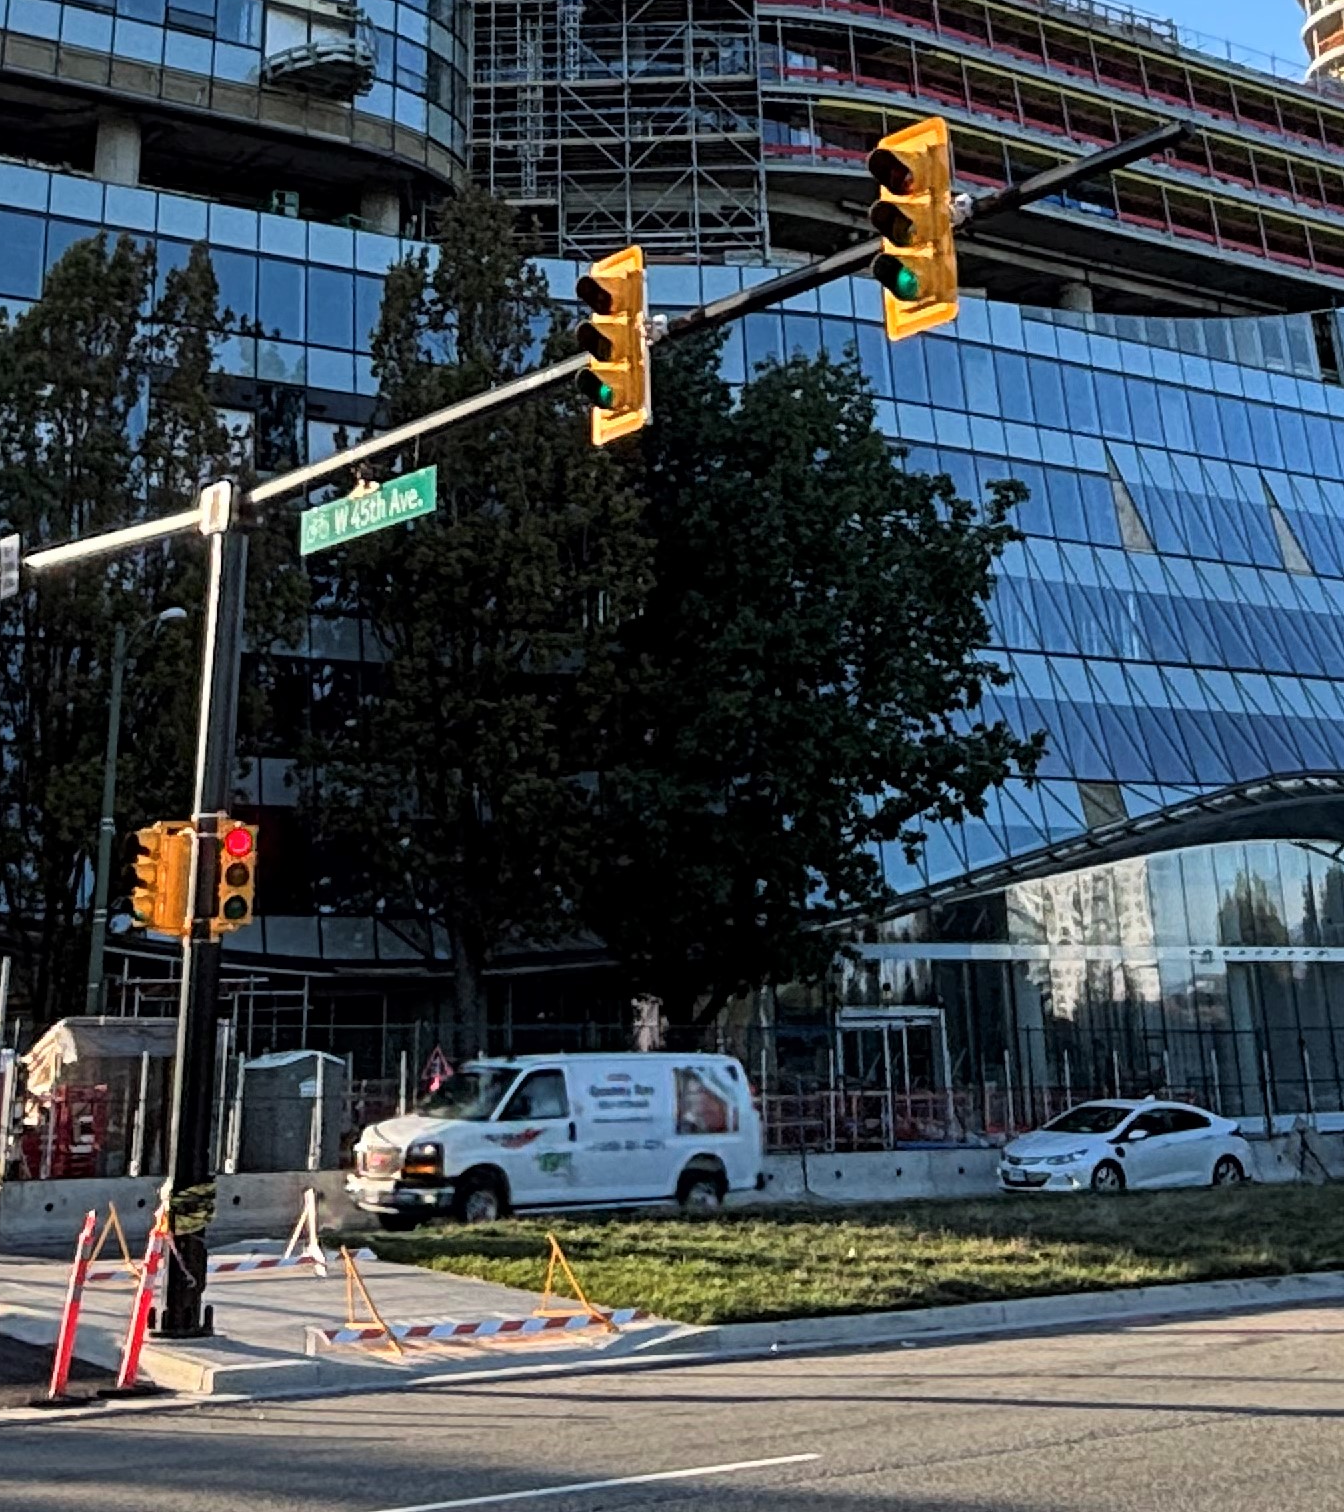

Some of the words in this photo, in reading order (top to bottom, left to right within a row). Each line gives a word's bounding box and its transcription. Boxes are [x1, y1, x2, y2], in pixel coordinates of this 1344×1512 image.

[334, 506, 348, 535] W
[351, 492, 386, 529] 45th
[389, 487, 423, 517] Ave.
